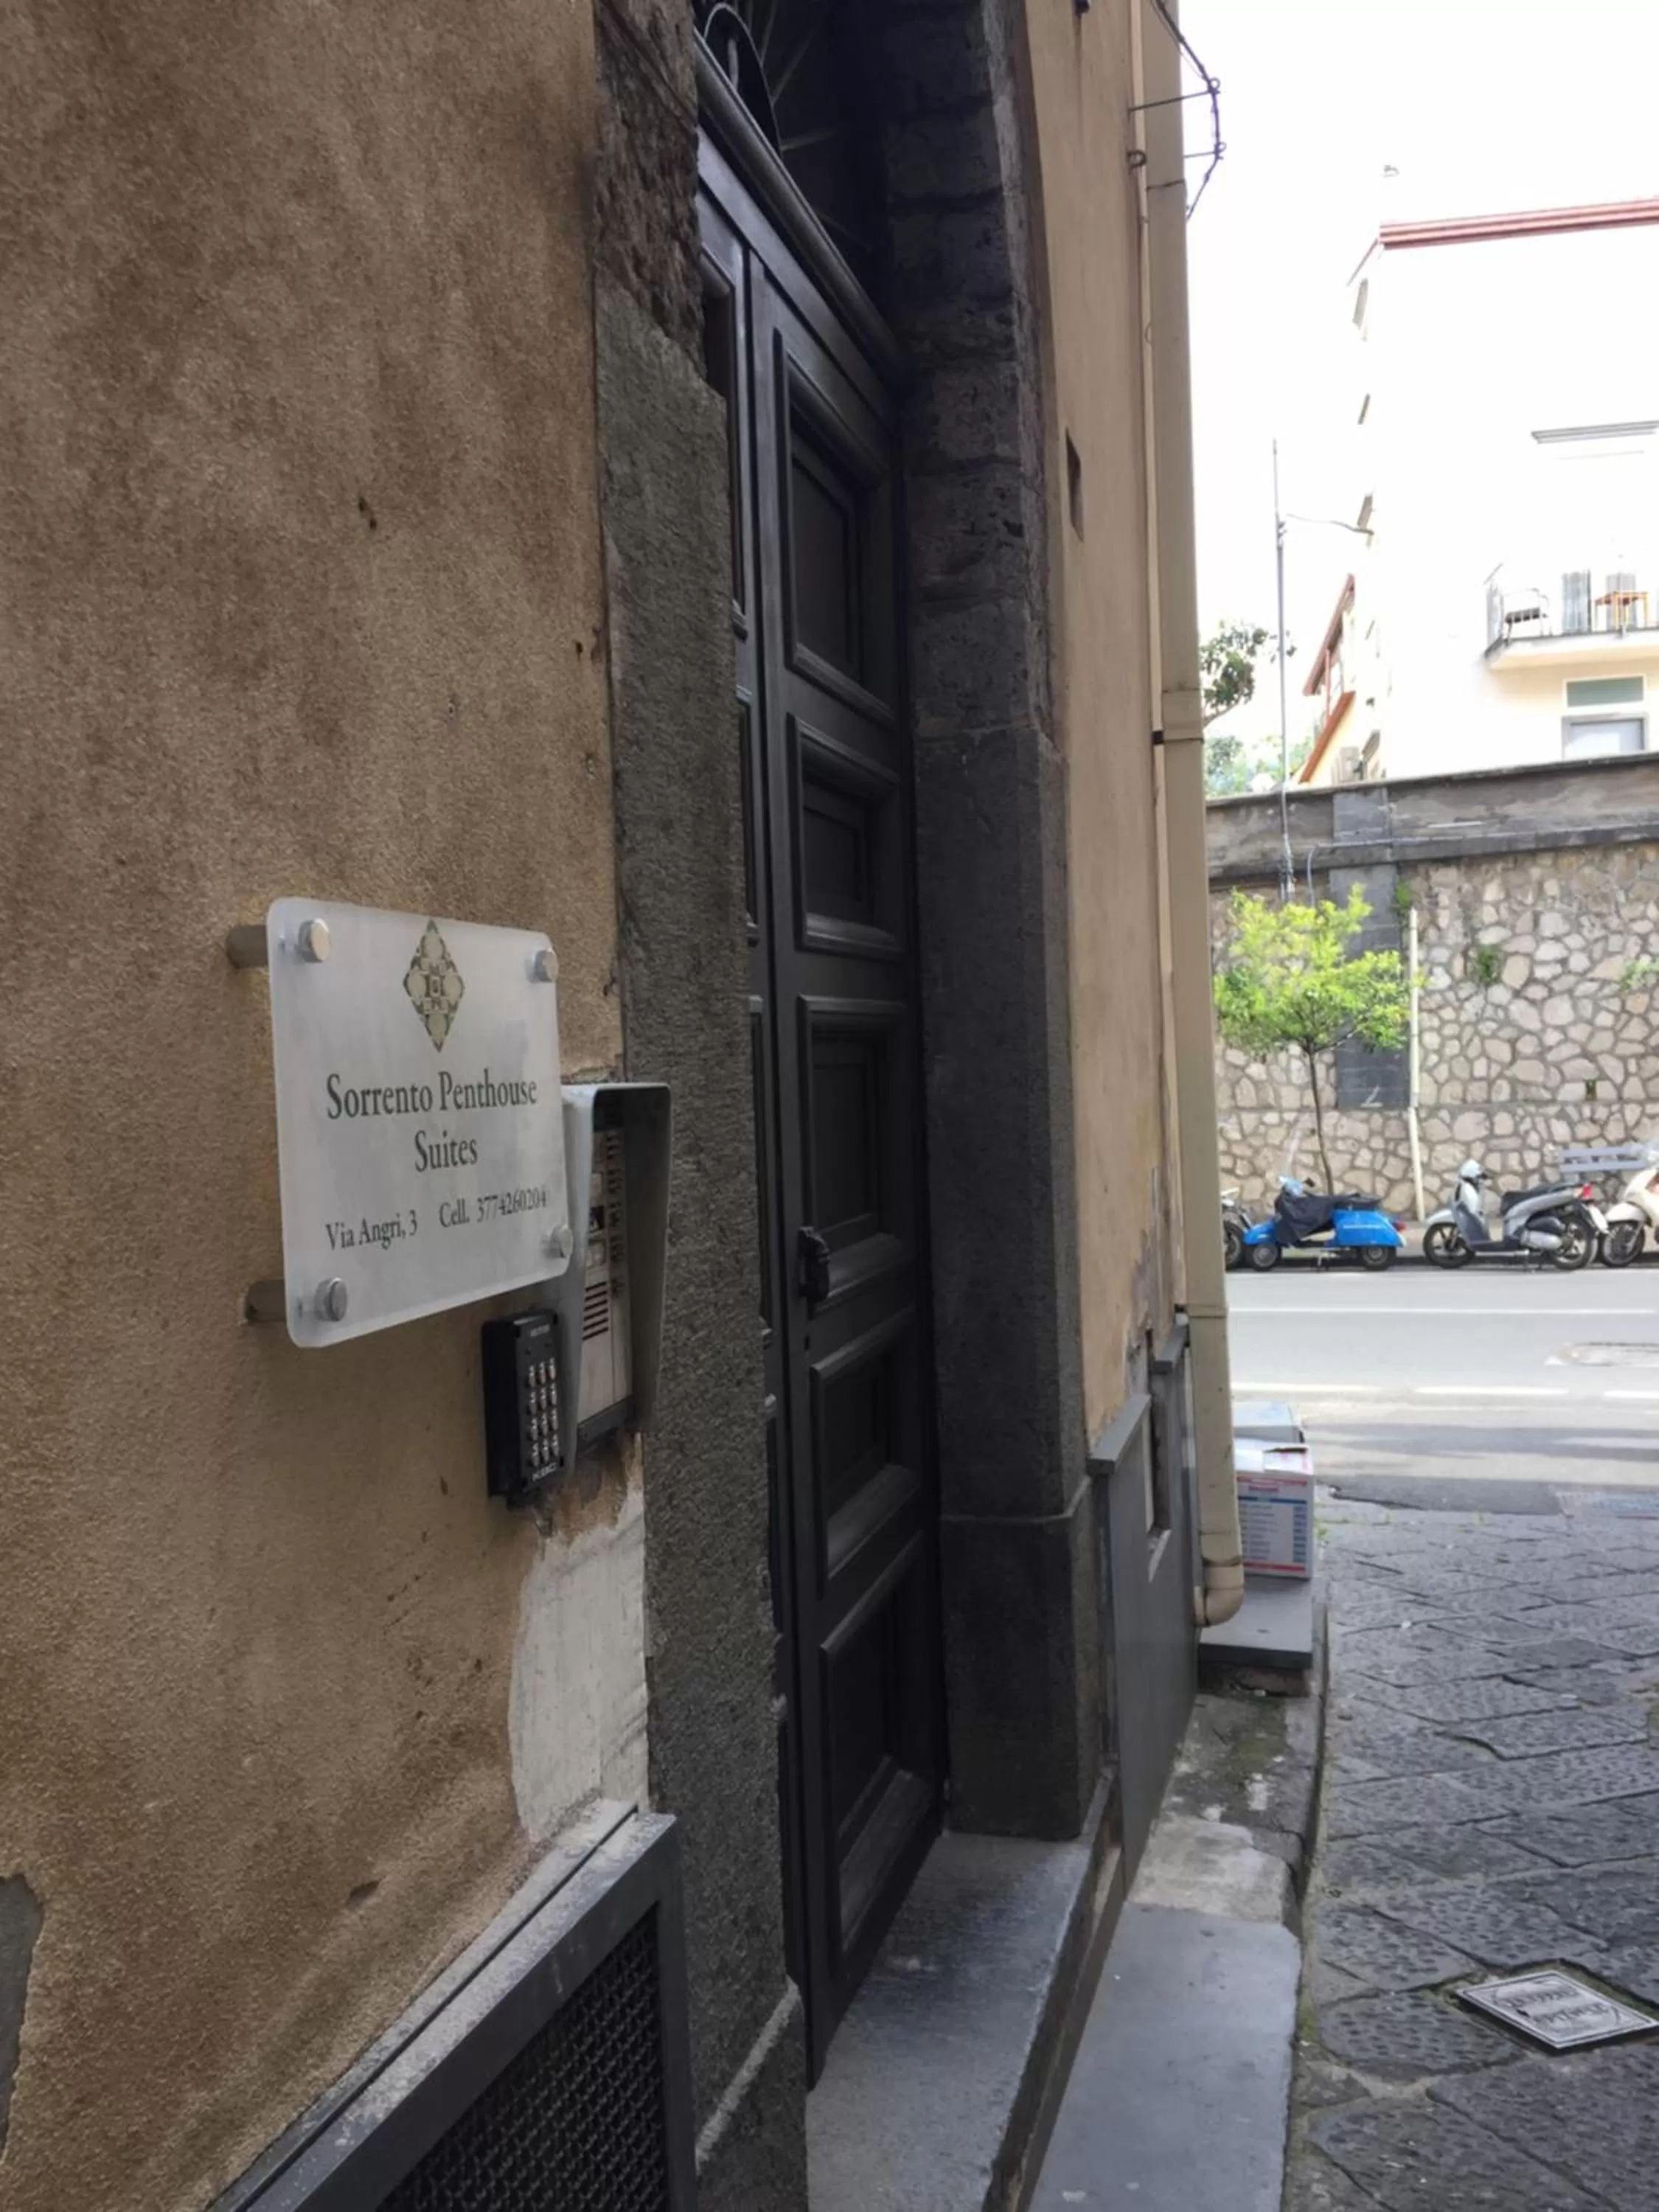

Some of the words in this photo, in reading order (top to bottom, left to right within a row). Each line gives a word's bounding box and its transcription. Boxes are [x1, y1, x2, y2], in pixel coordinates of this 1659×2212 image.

[327, 1073, 433, 1119] Sorrento
[437, 1068, 538, 1111] Penthouse
[414, 1129, 479, 1172] Suites
[325, 1222, 355, 1251] Via
[358, 1212, 406, 1250] Angri,
[408, 1209, 418, 1237] 3
[439, 1197, 470, 1228] Cell.
